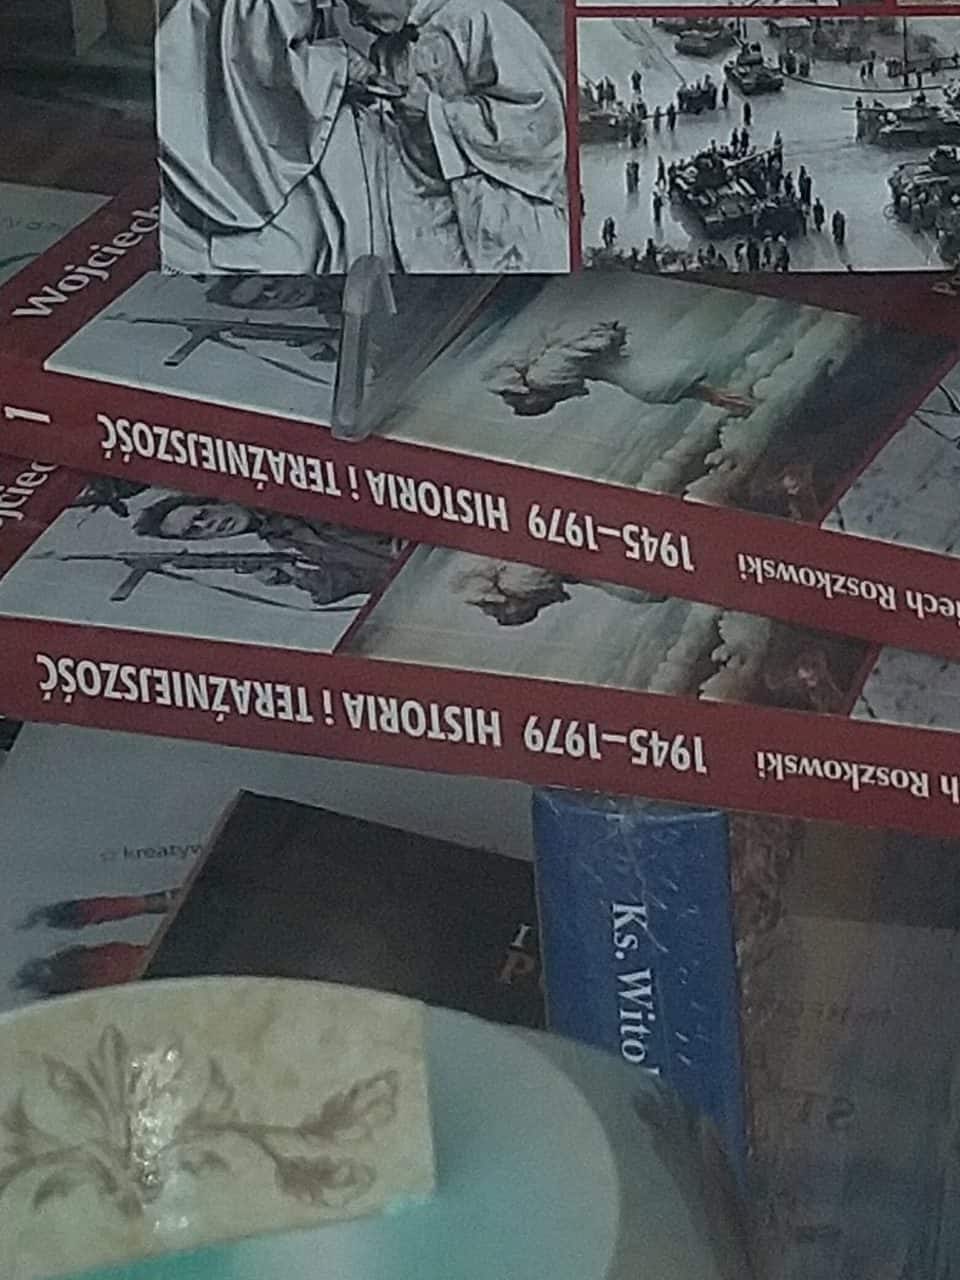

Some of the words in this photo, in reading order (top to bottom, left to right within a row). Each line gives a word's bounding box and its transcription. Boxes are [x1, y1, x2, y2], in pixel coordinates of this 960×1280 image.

[96, 413, 342, 498] TERAŹNIEJSZOŚĆ
[348, 465, 362, 502] i
[365, 469, 510, 533] HISTORIA
[737, 552, 897, 612] Roszkowski
[36, 653, 314, 724] TERAŹNIEJSZOŚĆ
[322, 689, 334, 725] i
[342, 692, 502, 748] HISTORIA
[755, 750, 930, 799] Roszkowski
[612, 902, 649, 960] Ks.
